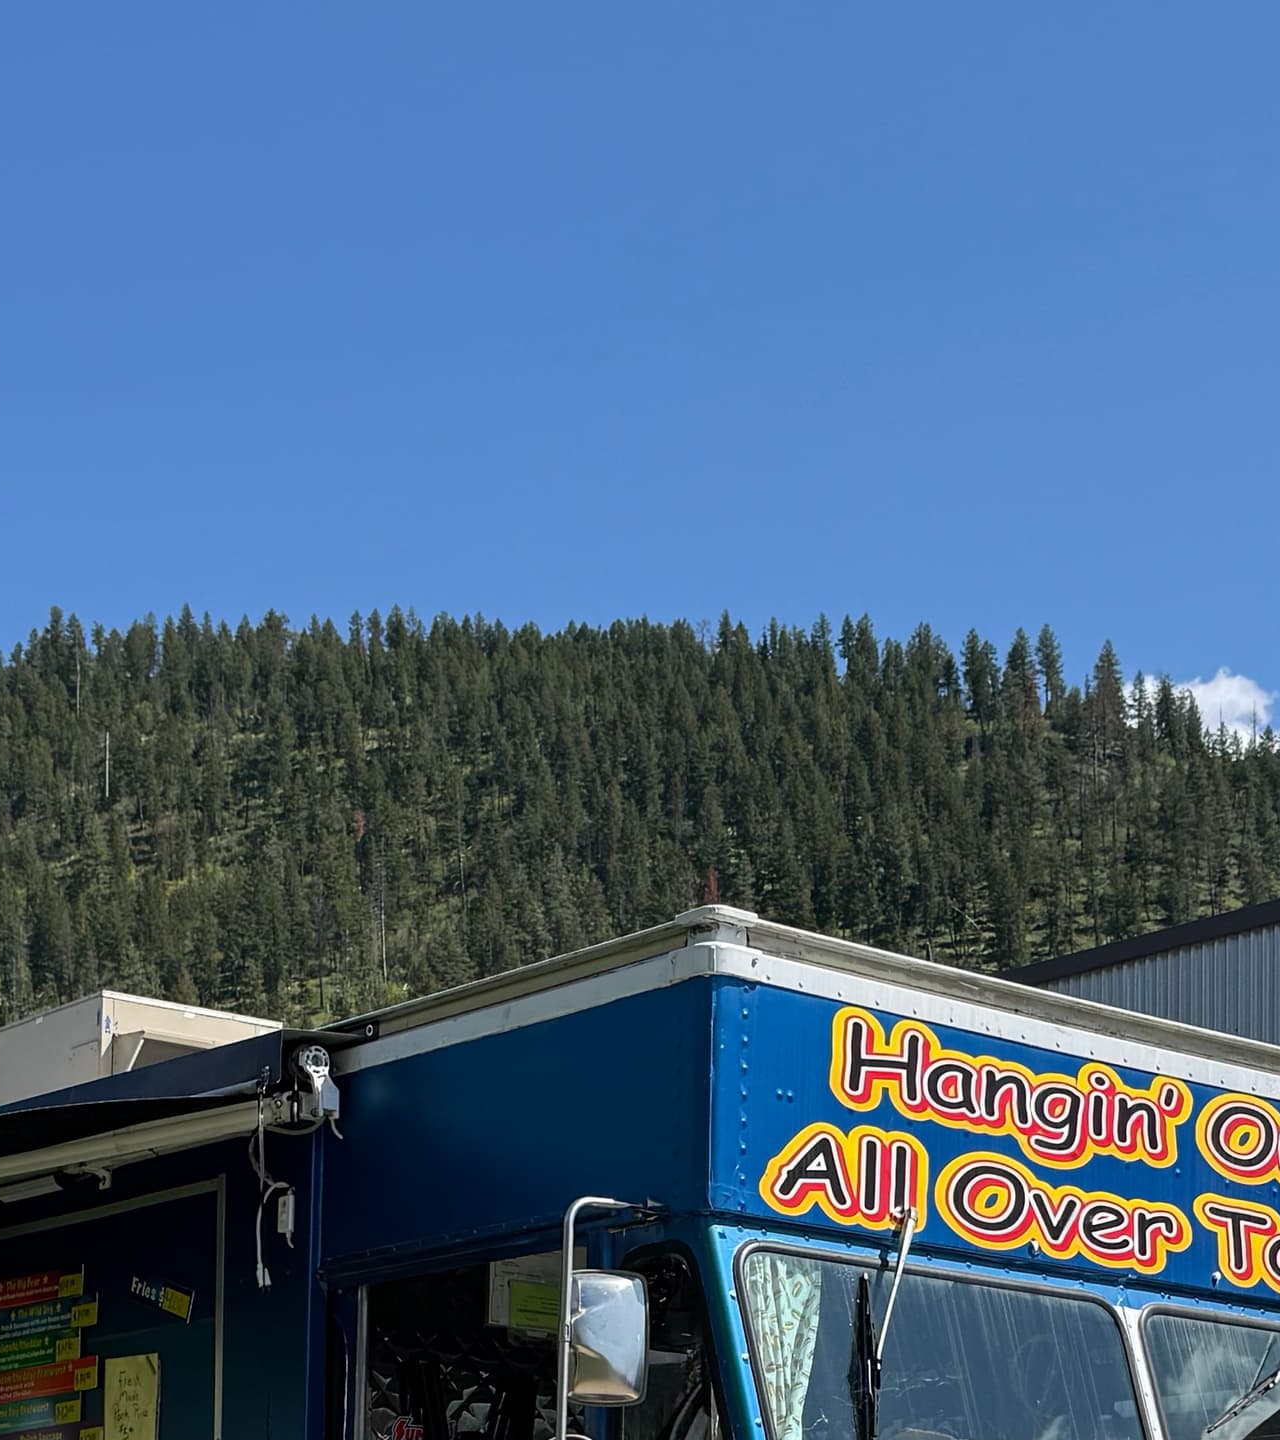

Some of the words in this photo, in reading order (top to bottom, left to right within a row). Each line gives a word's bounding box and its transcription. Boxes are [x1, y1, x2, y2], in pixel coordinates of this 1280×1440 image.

[832, 1006, 1194, 1169] Hangin'
[760, 1122, 928, 1231] All
[935, 1152, 1194, 1274] Over
[131, 1275, 158, 1302] Fries
